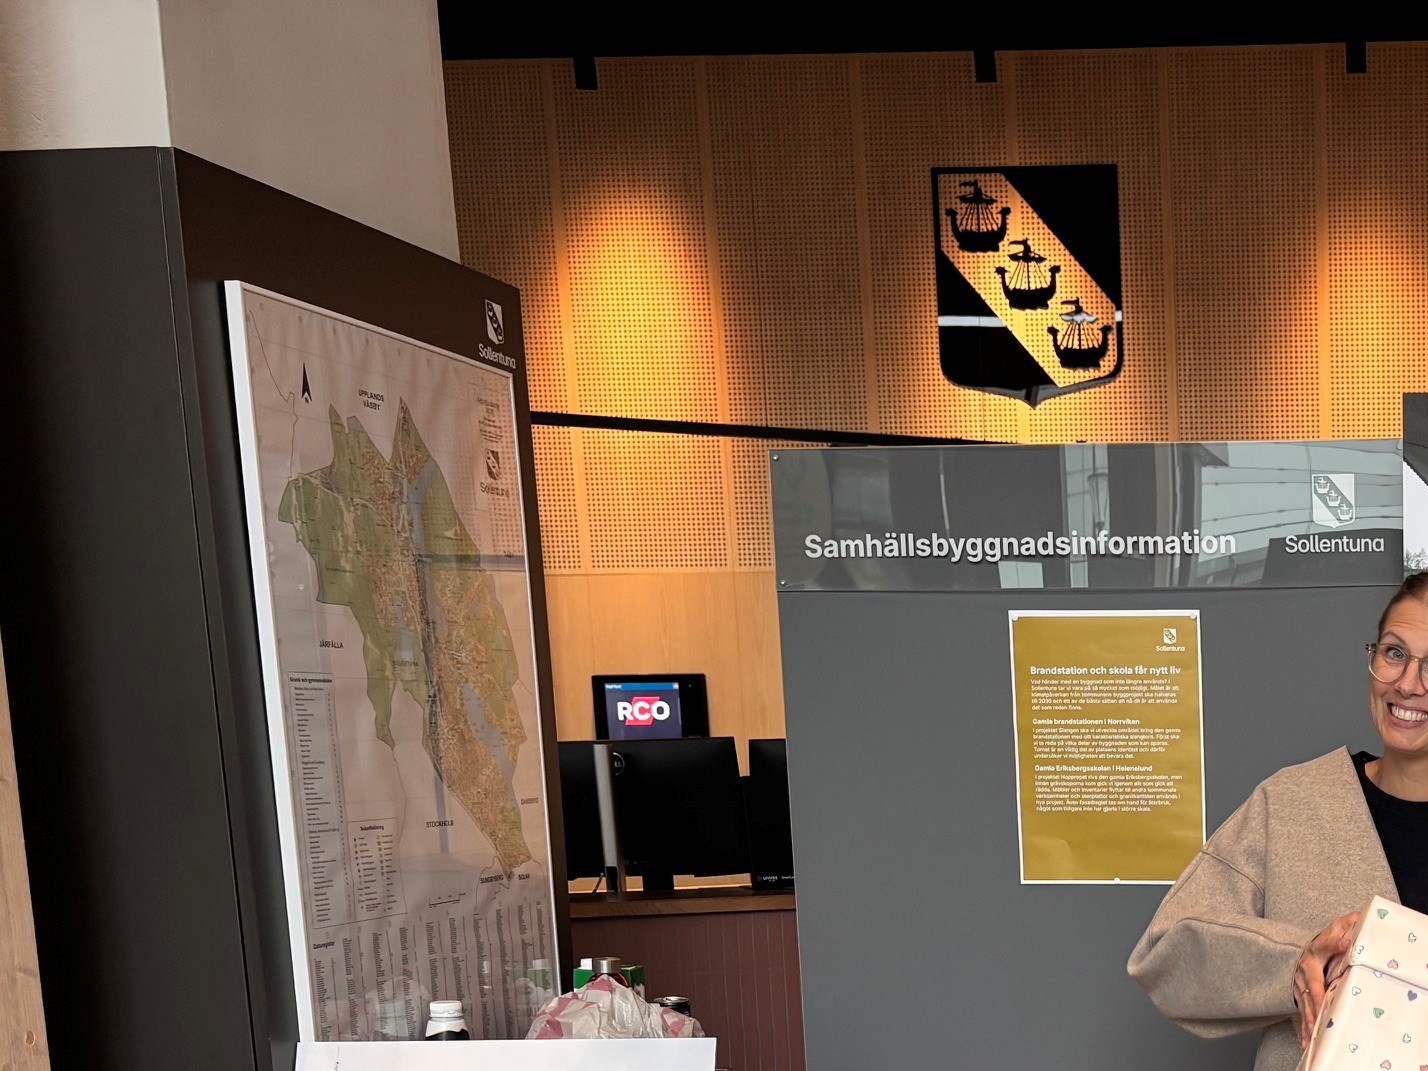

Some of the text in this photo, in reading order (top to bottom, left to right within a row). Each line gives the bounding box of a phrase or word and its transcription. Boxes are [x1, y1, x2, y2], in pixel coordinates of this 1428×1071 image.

[478, 343, 516, 369] Sollentuna
[804, 528, 1237, 563] Samhällsbyggnadsinformation
[1284, 534, 1385, 553] Sollentuna
[1030, 665, 1181, 676] Brandstation och skola får nytt liv
[617, 700, 670, 721] RCO
[1056, 765, 1111, 773] Eriksbergsskolan
